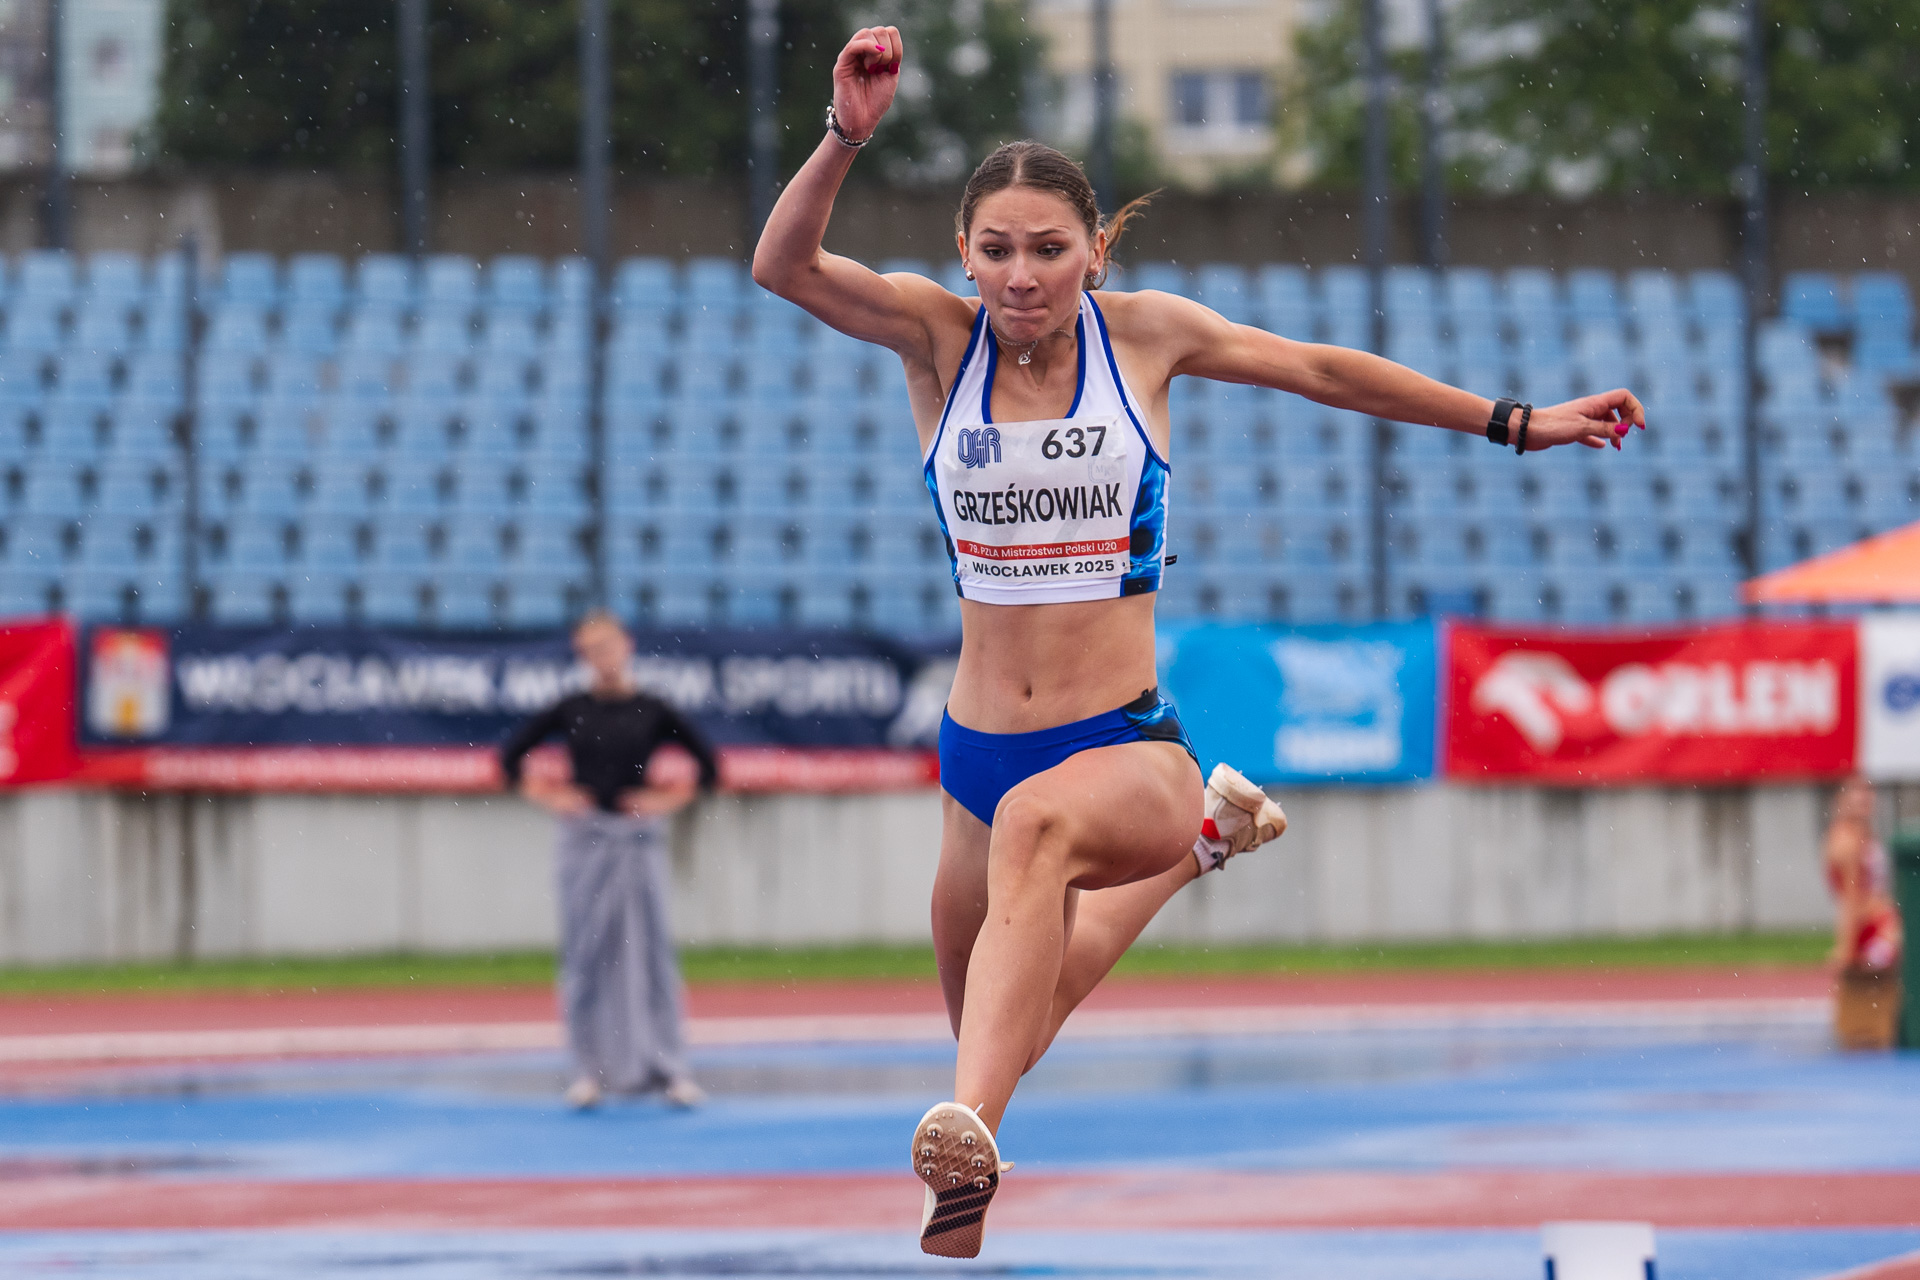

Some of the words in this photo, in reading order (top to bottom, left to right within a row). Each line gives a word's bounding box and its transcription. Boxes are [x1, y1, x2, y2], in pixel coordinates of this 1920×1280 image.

[1041, 425, 1107, 460] 637
[953, 483, 1123, 525] GRZEŚKOWIAK
[968, 543, 979, 554] 79.
[980, 546, 999, 557] PZLA
[1001, 546, 1062, 557] Mistrzostwa
[1065, 542, 1095, 555] Polski
[1097, 541, 1117, 551] U20
[972, 561, 1070, 577] WŁOCŁAWEK
[1074, 559, 1114, 573] 2025
[1602, 660, 1839, 735] ORLEN
